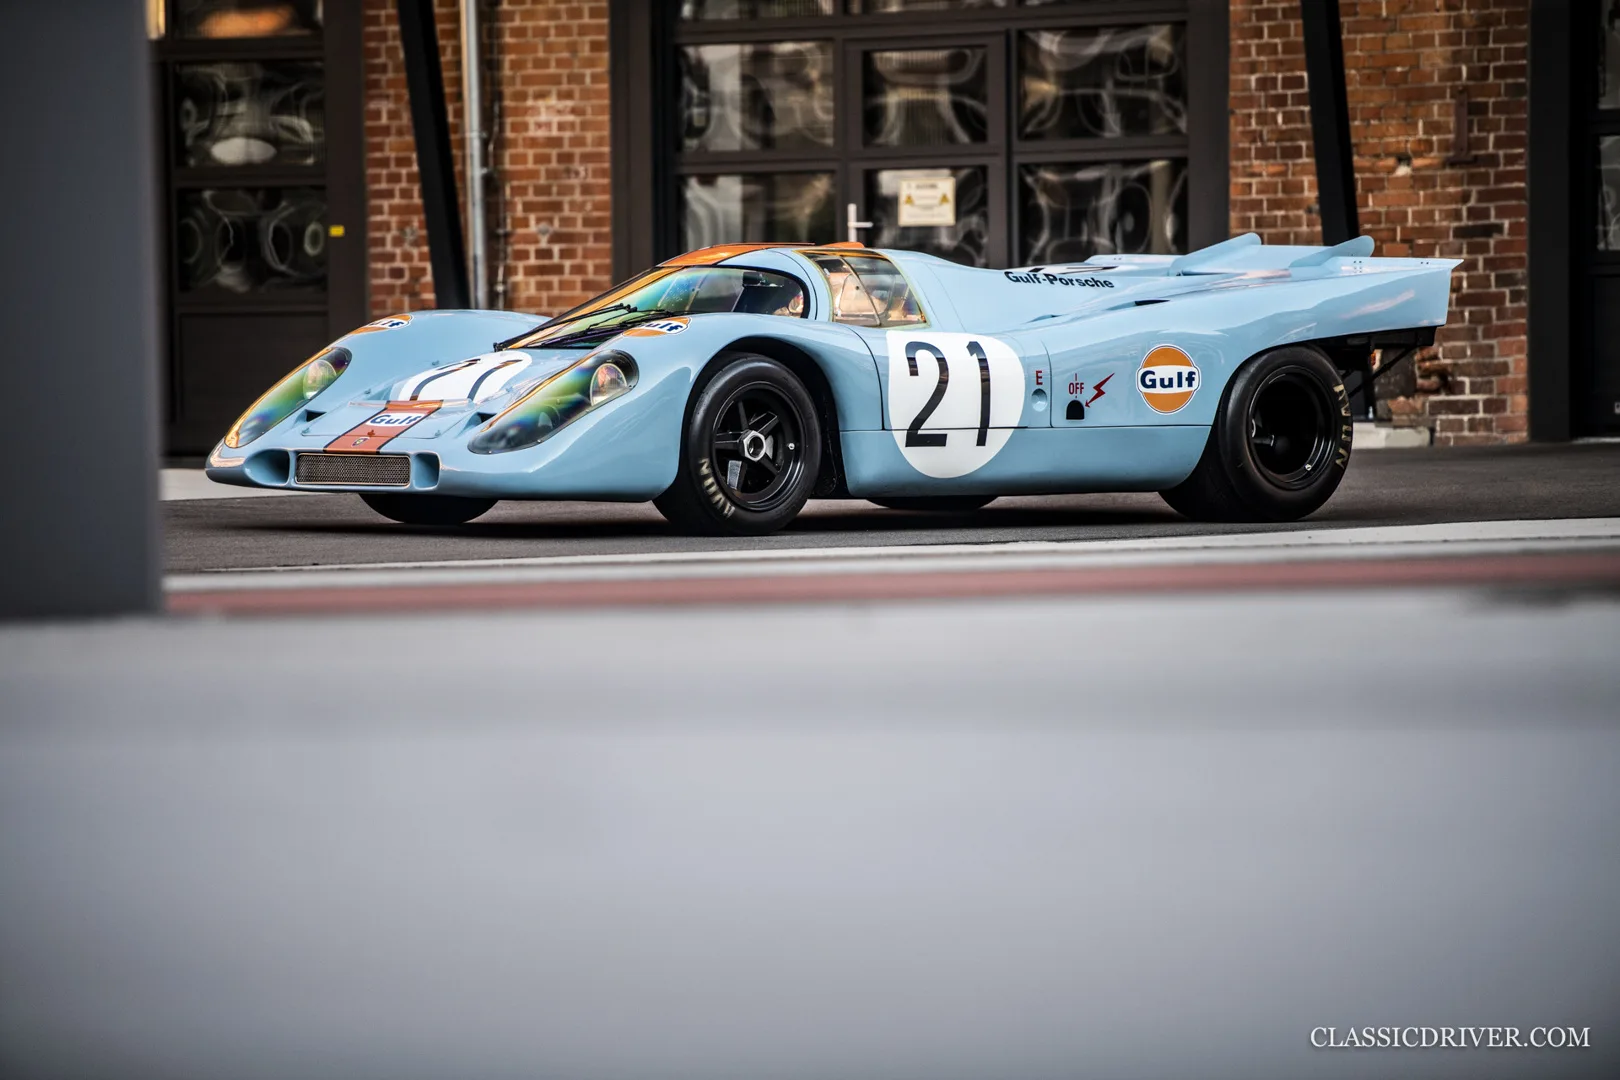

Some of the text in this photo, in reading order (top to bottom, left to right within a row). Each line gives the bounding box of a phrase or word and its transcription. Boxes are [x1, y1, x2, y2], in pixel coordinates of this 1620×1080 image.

[1003, 271, 1115, 289] Gulf-Porsche
[368, 320, 405, 328] ulf
[641, 322, 683, 332] ulf
[1035, 370, 1043, 386] E
[1140, 370, 1197, 389] Gulf
[904, 341, 991, 448] 21
[1068, 382, 1085, 396] OFF
[370, 414, 423, 427] Gulf
